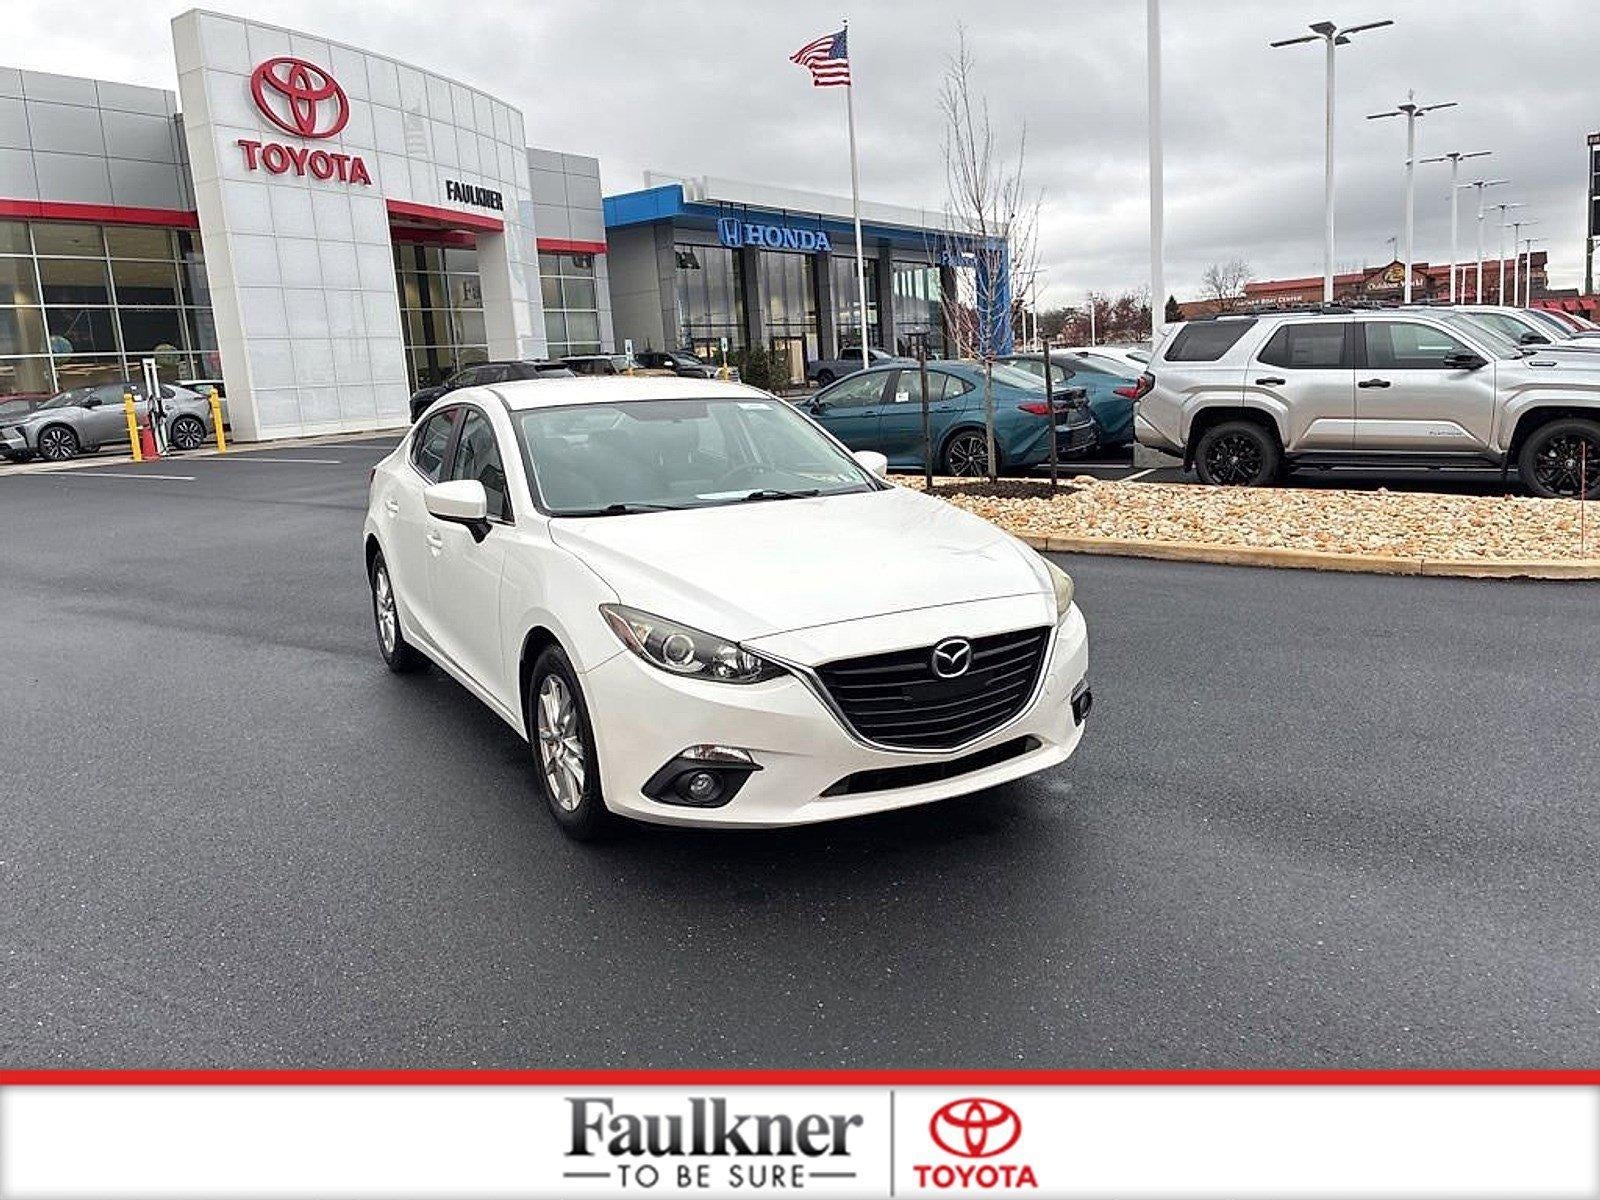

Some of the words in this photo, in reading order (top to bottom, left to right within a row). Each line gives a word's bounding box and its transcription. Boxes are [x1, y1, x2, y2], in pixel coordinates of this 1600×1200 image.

[238, 139, 372, 186] TOYOTA
[445, 180, 504, 211] FAULKNER
[744, 223, 832, 251] HONDA
